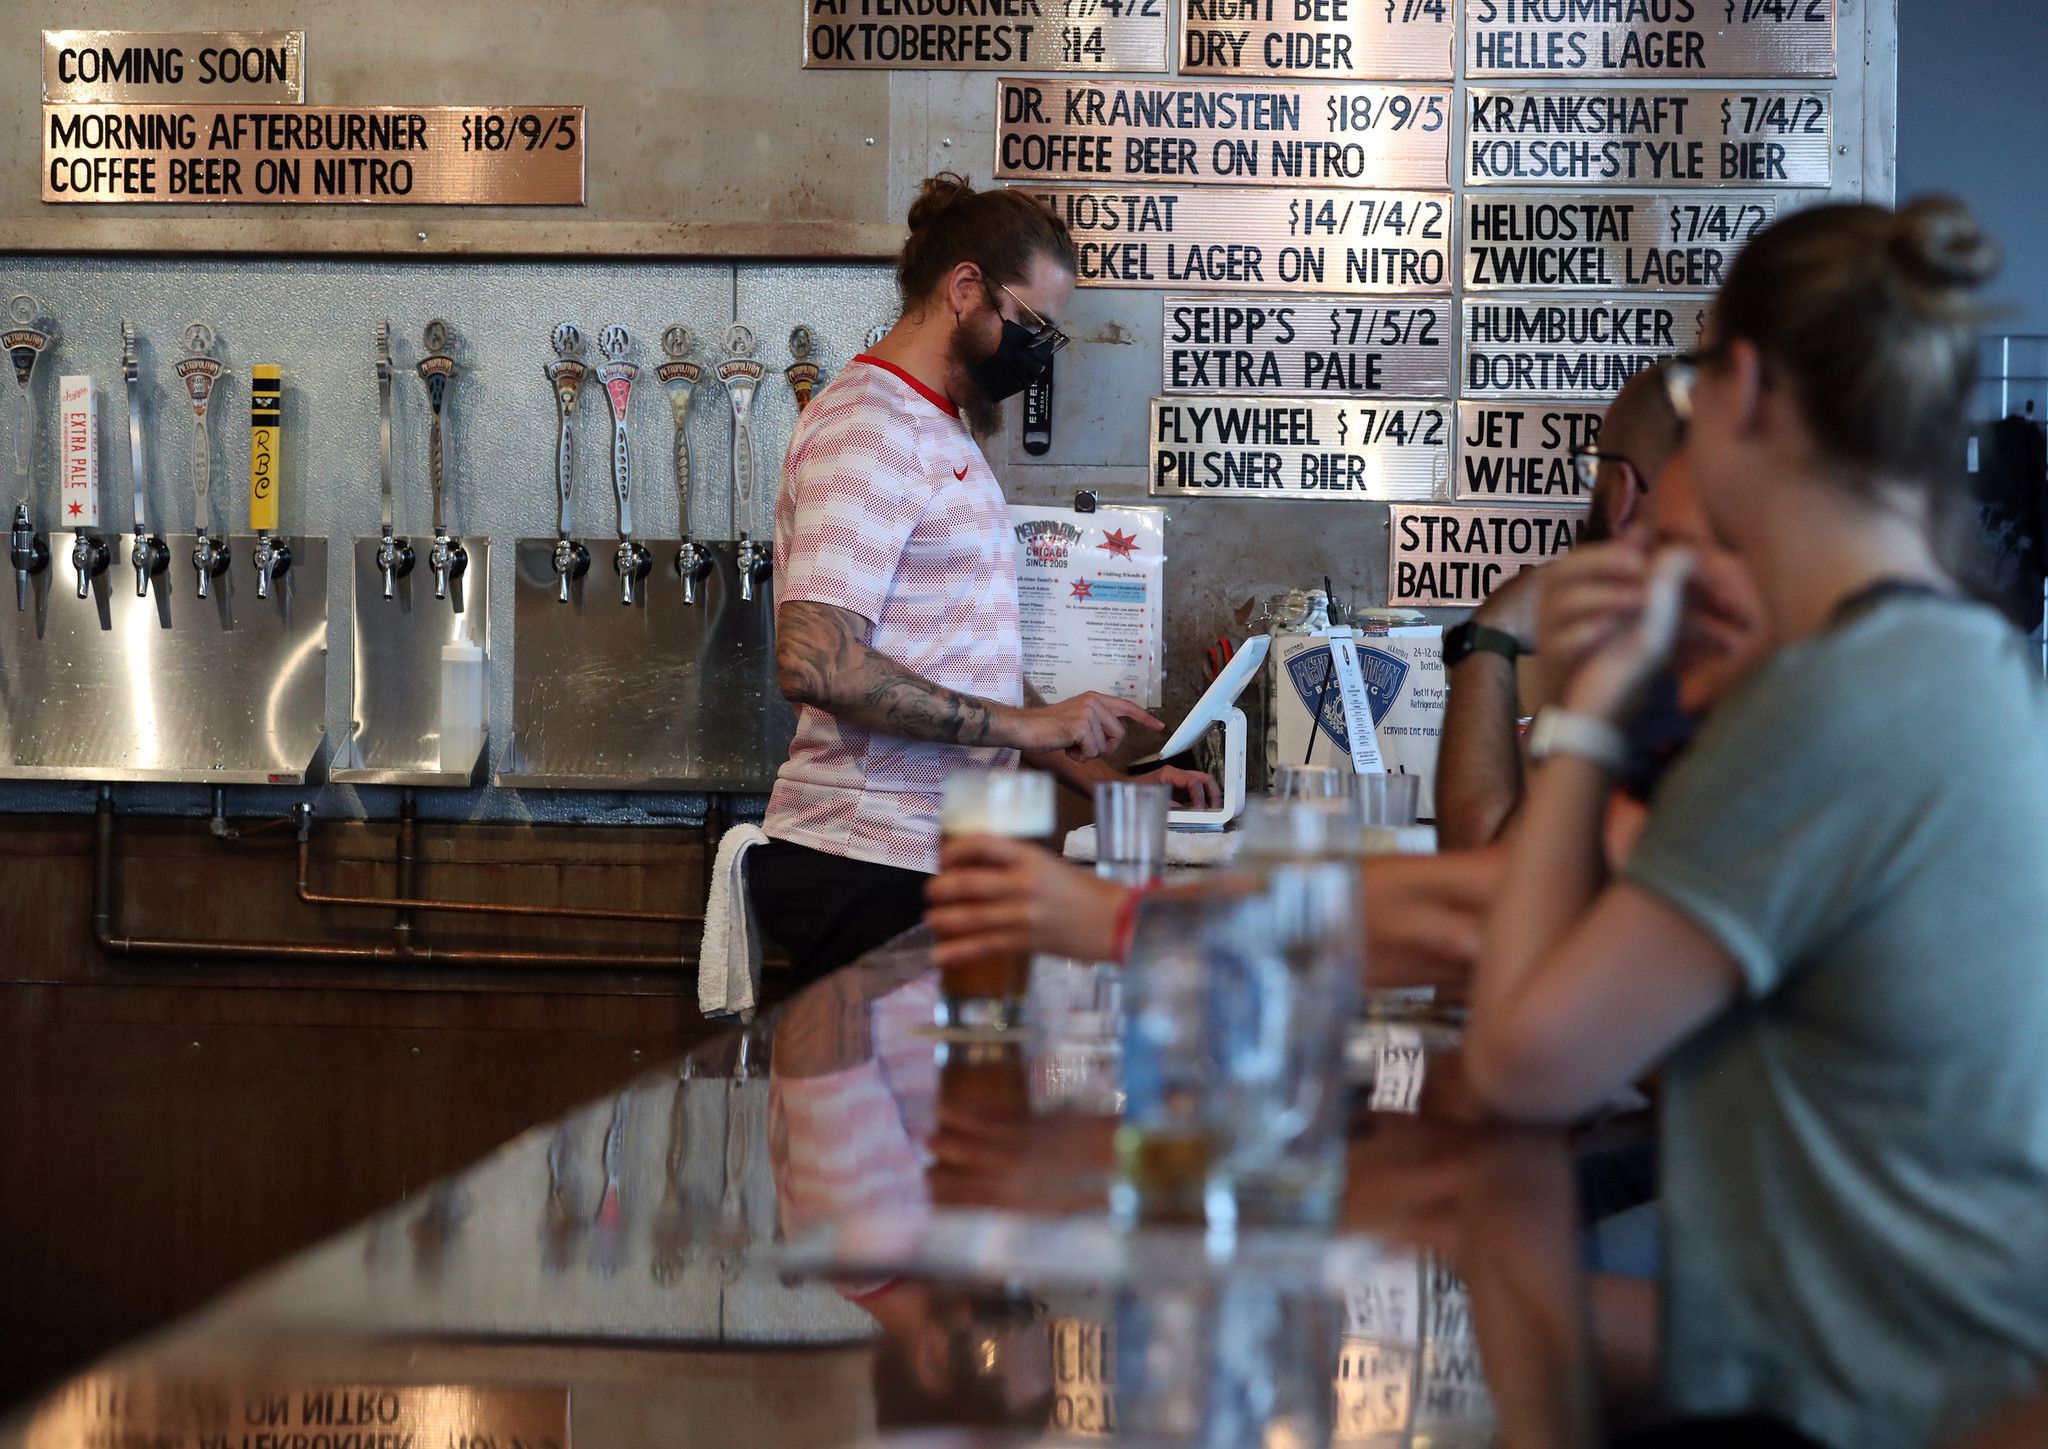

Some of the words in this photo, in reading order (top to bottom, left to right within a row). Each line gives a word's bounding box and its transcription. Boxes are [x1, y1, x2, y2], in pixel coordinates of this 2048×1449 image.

[1476, 0, 1695, 23] STROMHAUS
[811, 24, 1034, 62] OKTOBERFEST
[1062, 26, 1106, 63] $14
[1187, 30, 1251, 67] DRY
[1264, 32, 1353, 70] CIDER
[1476, 31, 1587, 69] HELLES
[1602, 31, 1706, 69] LAGER
[58, 48, 184, 84] COMING
[199, 48, 288, 84] SOON
[1003, 86, 1053, 126] DR.
[1065, 88, 1301, 132] KRANKENSTEIN
[1327, 94, 1445, 134] $18/9/5
[1472, 96, 1686, 134] KRANKSHAFT
[51, 114, 196, 151] MORNING
[208, 114, 428, 151] AFTERBURNER
[461, 115, 577, 152] $18/9/5
[1001, 133, 1112, 175] COFFEE
[1124, 136, 1197, 176] BEER
[1212, 138, 1269, 178] ON
[1271, 140, 1367, 179] NITRO
[1472, 140, 1704, 180] KOLSCH-STYLE
[1720, 141, 1788, 181] BIER
[50, 157, 157, 195] COFFEE
[169, 158, 243, 195] BEER
[255, 159, 301, 195] ON
[314, 159, 415, 197] NITRO
[1036, 194, 1178, 232] IOSTAT
[1287, 198, 1444, 242] $14/7/4/2
[1471, 204, 1634, 242] HELIOSTAT
[1168, 244, 1261, 282] LAGER
[1278, 246, 1325, 285] ON
[1346, 247, 1445, 287] NITRO
[1471, 247, 1612, 286] ZWICKEL
[1625, 249, 1725, 287] LAGER
[1172, 306, 1296, 345] SEIPP'S
[1330, 307, 1440, 347] $7/5/2
[1471, 306, 1675, 347] HUMBUCKER
[1172, 350, 1280, 389] EXTRA
[1304, 351, 1383, 391] PALE
[1028, 382, 1038, 424] EFFE
[71, 412, 86, 452] EXTRA
[1158, 406, 1320, 447] FLYWHEEL
[1465, 410, 1524, 449] JET
[1540, 412, 1604, 450] STR
[71, 458, 87, 489] PALE
[1157, 450, 1283, 490] PILSNER
[1300, 452, 1367, 491] BIER
[1026, 546, 1069, 558] CHICAGO
[1026, 558, 1048, 567] SINCE
[1049, 559, 1068, 568] 2009
[1420, 661, 1443, 671] Bottles
